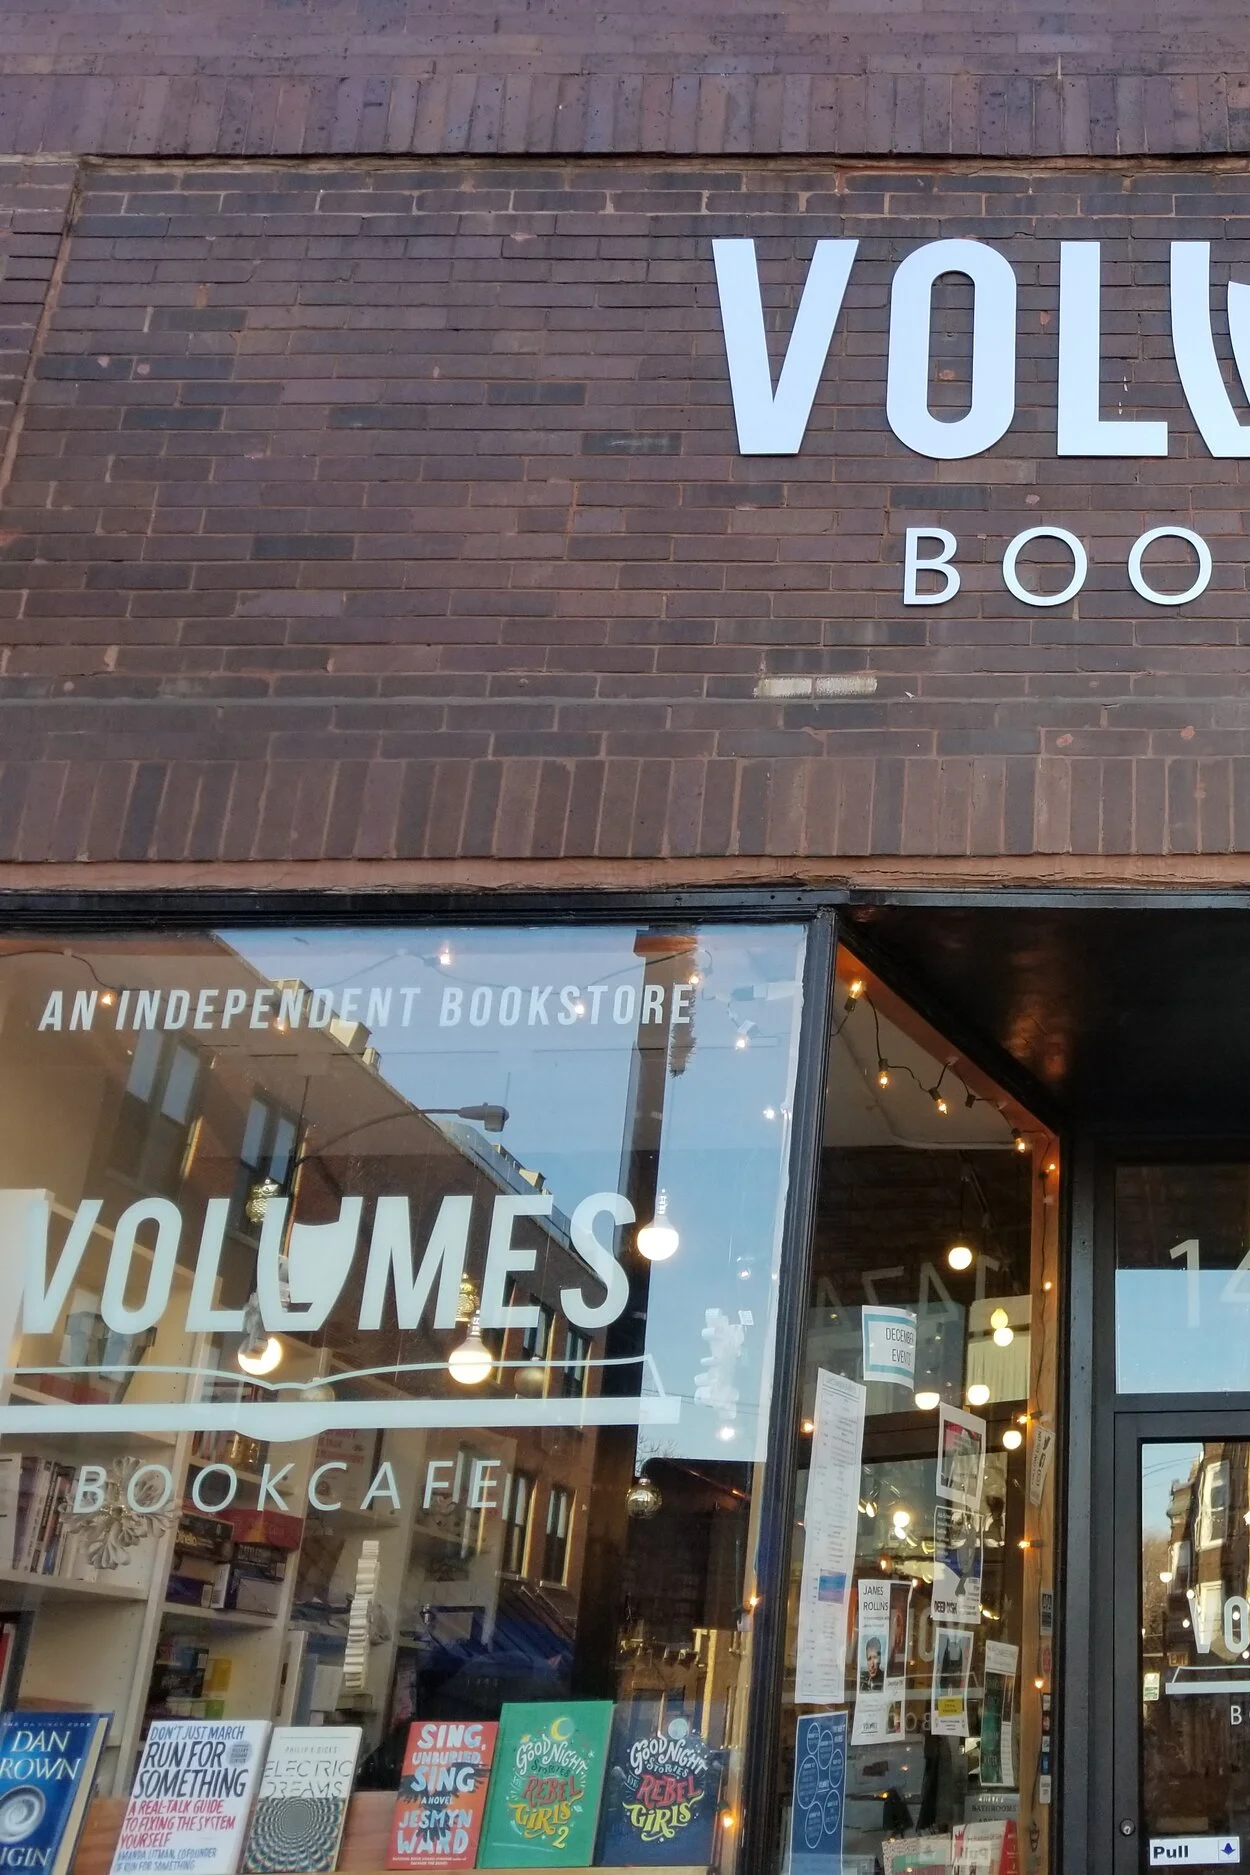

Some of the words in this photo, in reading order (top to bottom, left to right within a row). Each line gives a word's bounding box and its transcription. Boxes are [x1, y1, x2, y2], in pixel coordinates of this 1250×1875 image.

[38, 988, 97, 1031] AN
[115, 986, 421, 1030] INDEPENDENT
[439, 983, 697, 1026] BOOKSTORE
[23, 1192, 636, 1334] VOLUMES
[885, 1327, 914, 1346] DECEMBER
[73, 1460, 501, 1513] BOOKCAFE
[863, 1585, 884, 1596] JAMES
[863, 1601, 889, 1612] ROLLINS
[11, 1729, 70, 1753] DAN
[151, 1725, 185, 1740] DON'T
[184, 1726, 208, 1740] JUST
[208, 1725, 245, 1740] MARCH
[143, 1741, 187, 1768] RUN
[186, 1740, 226, 1768] FOR
[263, 1760, 353, 1778] ELECTRIC
[410, 1765, 476, 1795] SING
[133, 1768, 249, 1799] SOMETHING
[522, 1775, 583, 1808] REBEL
[636, 1772, 702, 1809] REBEL
[128, 1801, 137, 1816] A
[193, 1799, 225, 1814] GUIDE
[421, 1796, 427, 1805] A
[428, 1796, 454, 1805] NOVEL
[125, 1817, 138, 1832] TO
[138, 1816, 176, 1831] FIXING
[176, 1816, 197, 1831] THE
[197, 1815, 236, 1831] SYSTEM
[399, 1808, 473, 1829] JESMYN
[120, 1832, 173, 1849] YOURSELF
[397, 1828, 469, 1855] WARD
[552, 1826, 569, 1849] 2
[1153, 1845, 1189, 1859] Pull
